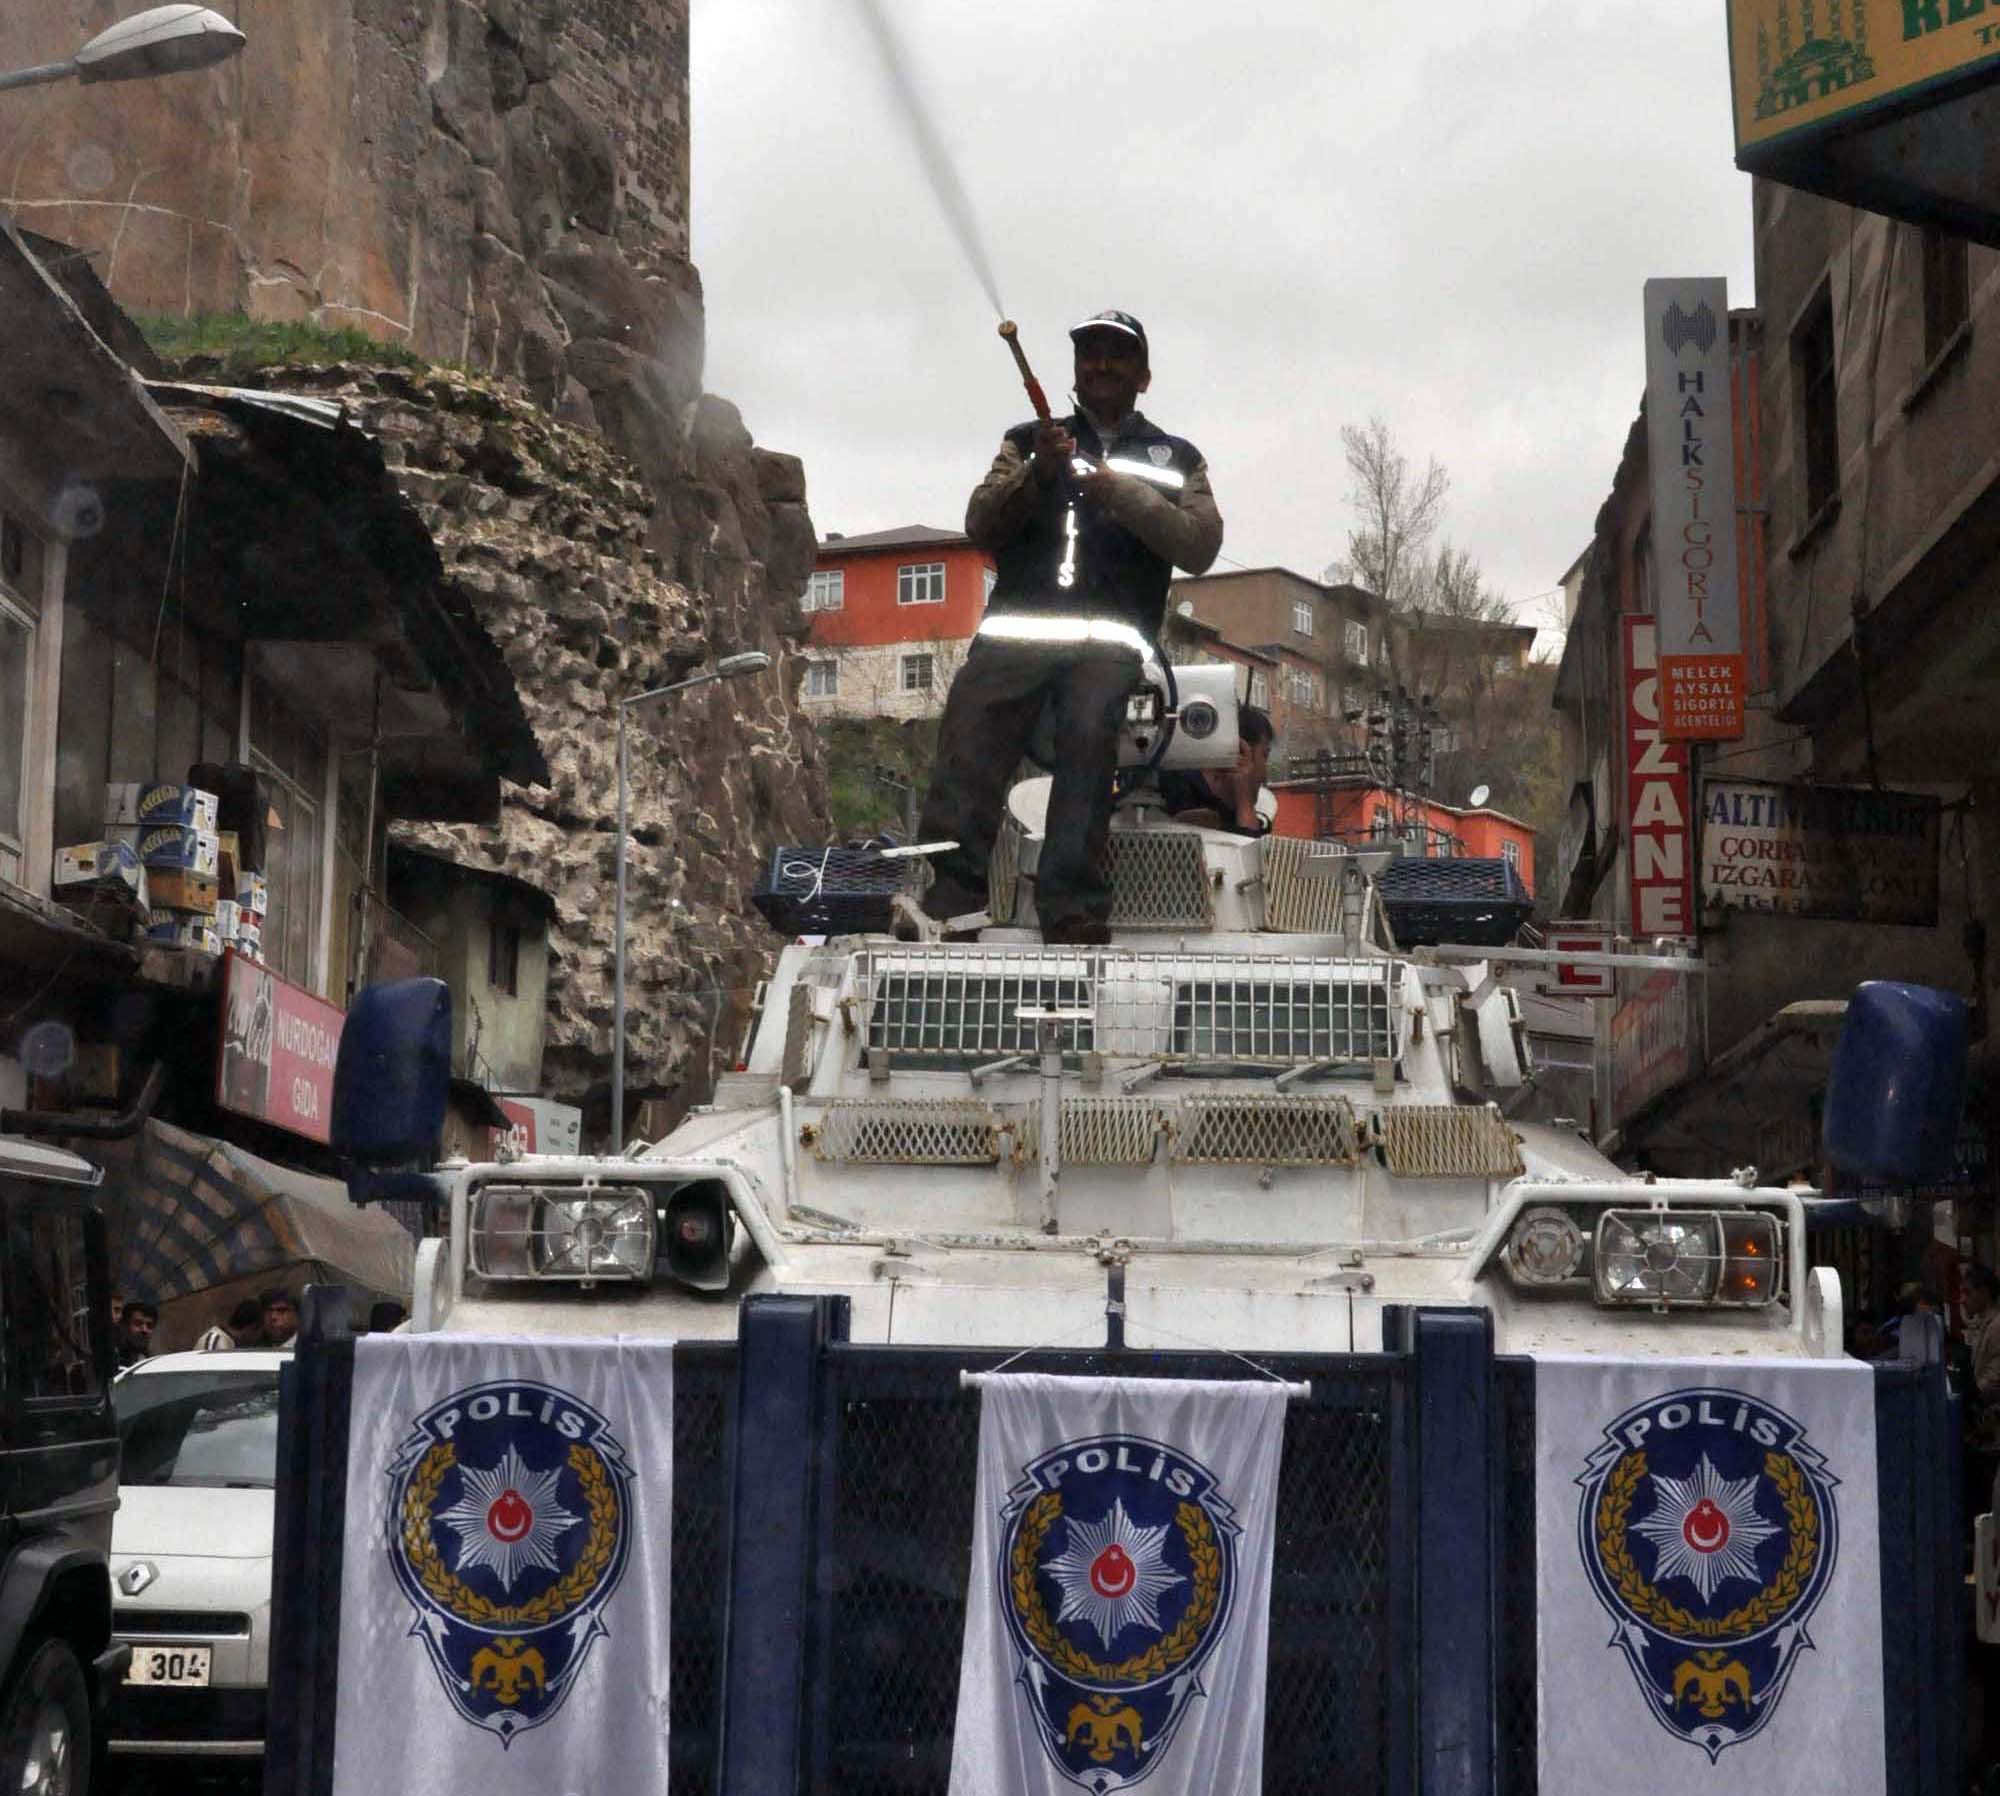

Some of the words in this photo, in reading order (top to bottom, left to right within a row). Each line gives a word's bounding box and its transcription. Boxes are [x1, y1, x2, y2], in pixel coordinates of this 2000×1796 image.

[1672, 666, 1732, 680] MELEK
[1674, 681, 1734, 695] AYSAL
[435, 1392, 585, 1440] POLİS
[1623, 1400, 1781, 1448] POLİS
[1041, 1447, 1195, 1497] POLİS
